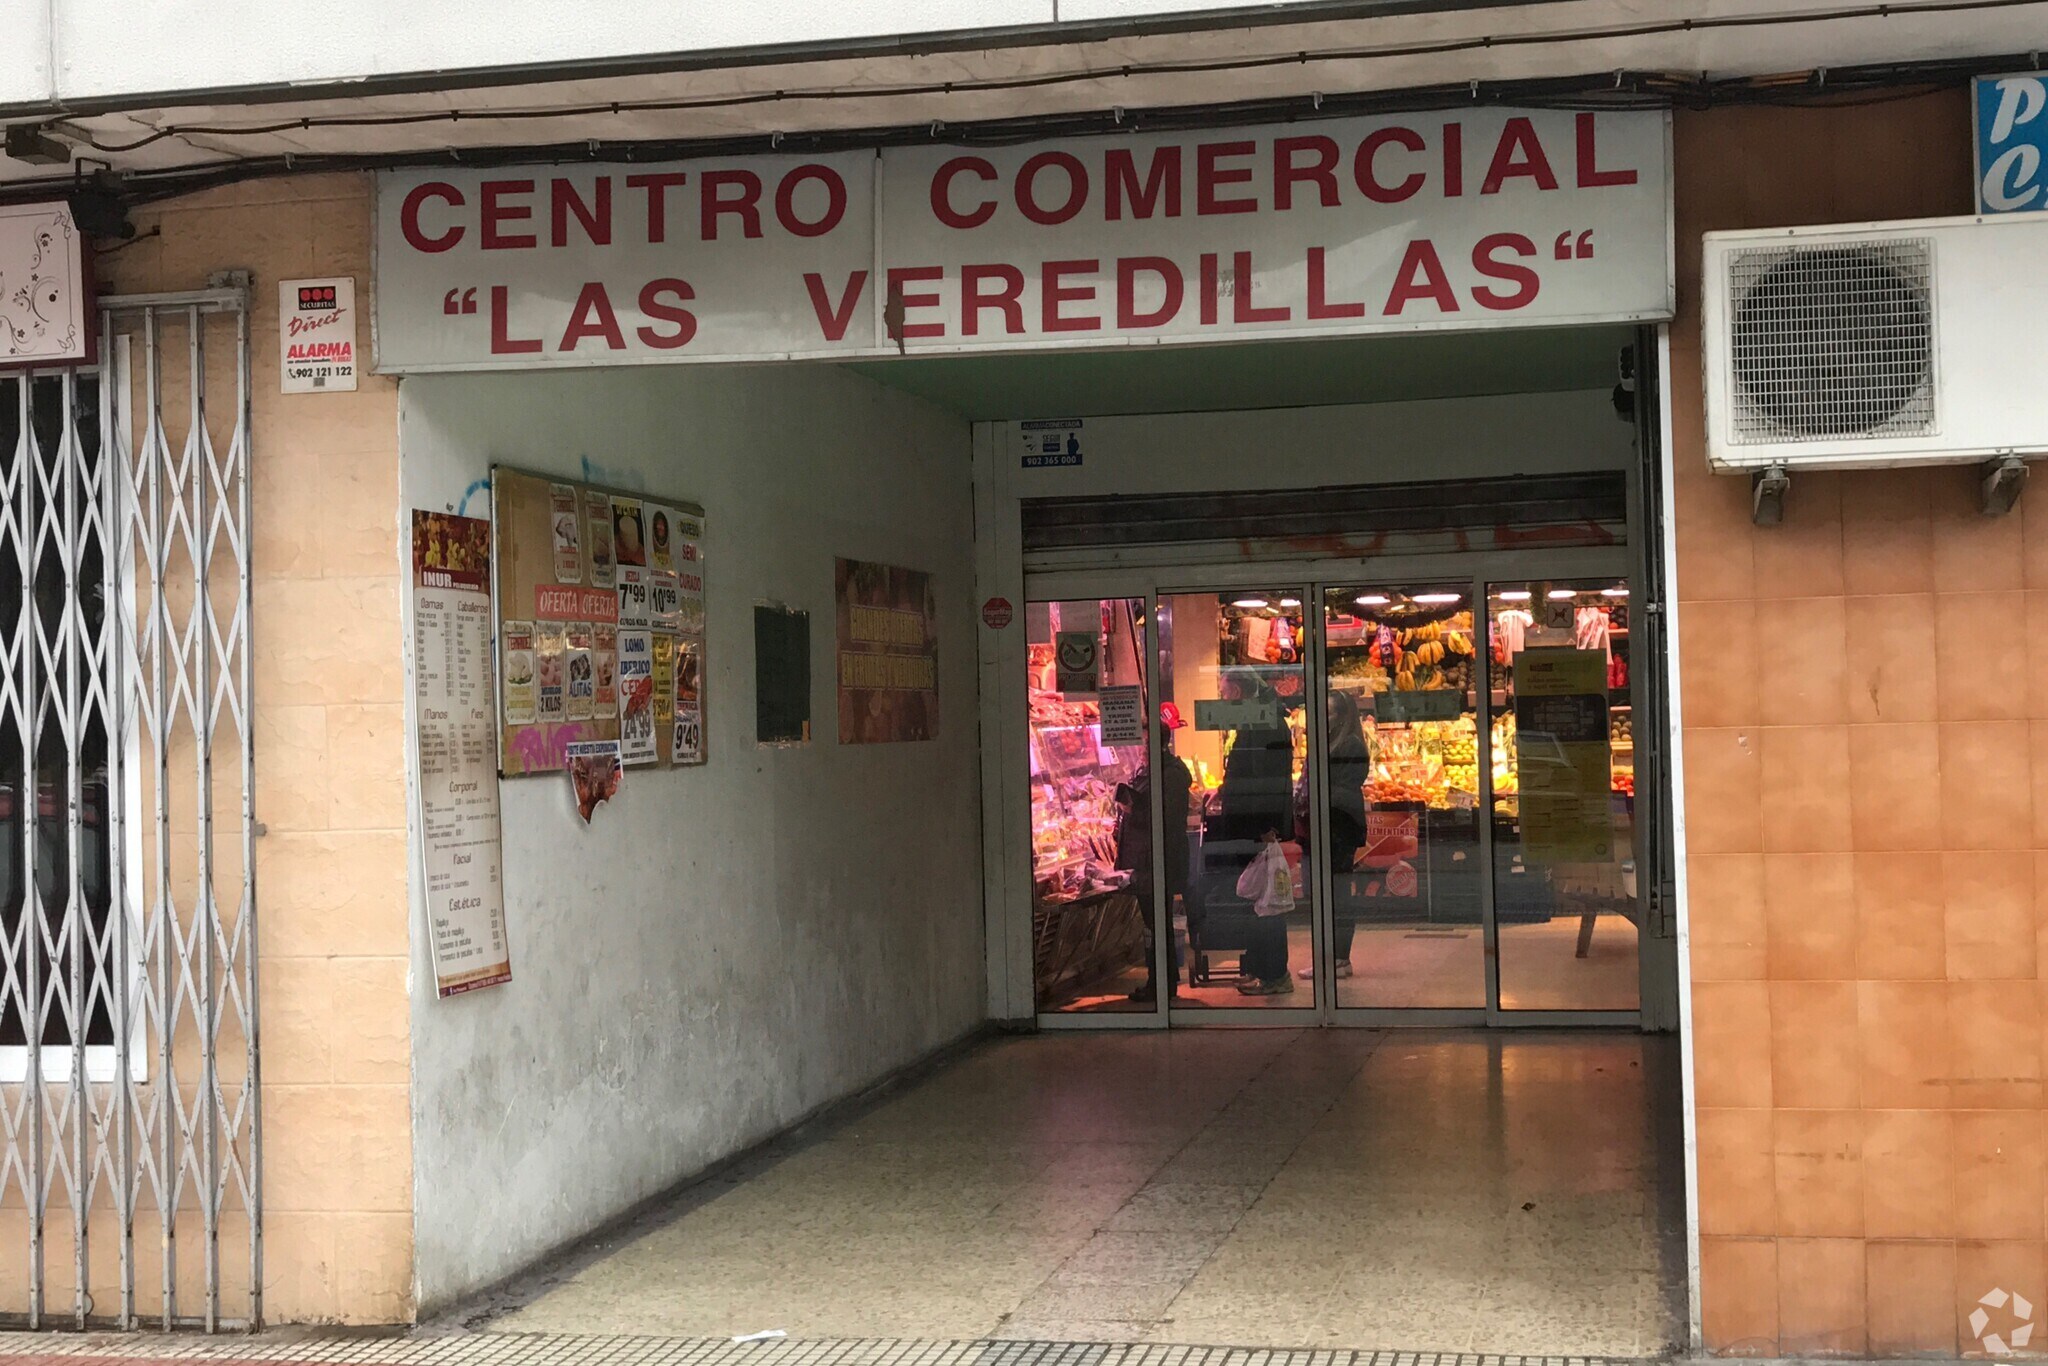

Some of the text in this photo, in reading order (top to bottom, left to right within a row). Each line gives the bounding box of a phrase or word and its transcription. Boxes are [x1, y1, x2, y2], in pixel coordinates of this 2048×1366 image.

[400, 112, 1638, 254] CENTRO COMERCIAL
[288, 308, 347, 337] Direct
[287, 342, 352, 359] ALARMA
[296, 366, 352, 378] 902 121 122
[1027, 455, 1077, 466] 902 365 000
[423, 571, 452, 588] INUR
[679, 572, 702, 592] CURADO
[539, 590, 616, 618] OFERTA OFERTA
[619, 583, 646, 610] 7'99
[652, 587, 676, 613] 10'99
[421, 597, 489, 614] Damas Caballeros
[624, 638, 645, 653] LOMO
[620, 660, 650, 675] IBERICO
[1059, 673, 1095, 682] PROHIBIDO
[569, 681, 592, 698] ALITAS
[540, 697, 545, 713] 2
[545, 696, 561, 712] KILOS
[424, 708, 448, 720] Manos
[676, 724, 699, 750] 9'49
[449, 781, 478, 795] Corporal
[453, 853, 472, 865] Facial
[449, 896, 481, 912] Estética
